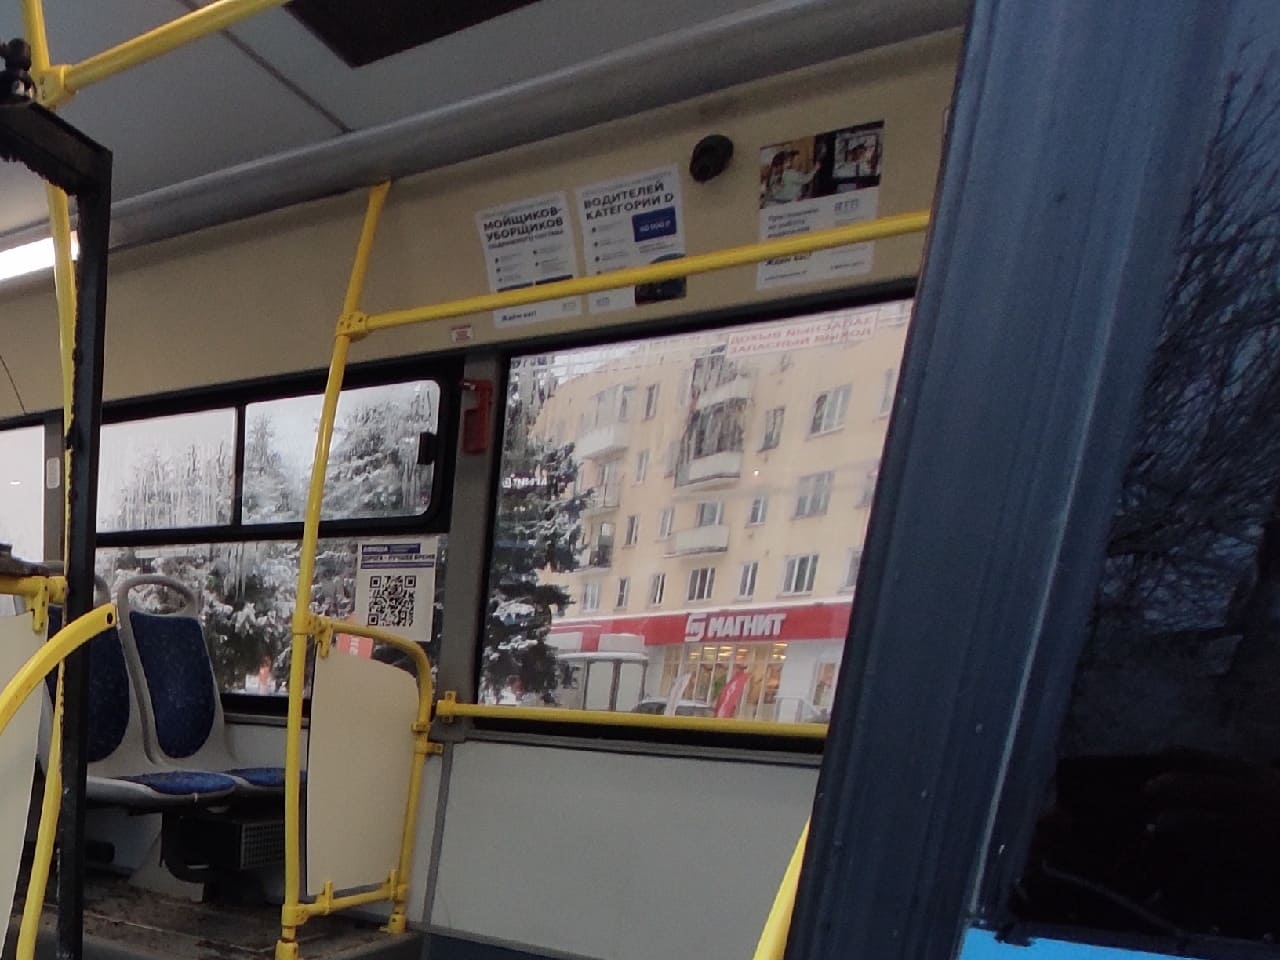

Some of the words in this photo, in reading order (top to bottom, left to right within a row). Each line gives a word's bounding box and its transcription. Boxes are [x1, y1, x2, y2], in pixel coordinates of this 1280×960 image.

[584, 180, 664, 209] ВОДИТЕЛЕЙ
[586, 196, 661, 221] КАТЕГОРИИ
[664, 193, 674, 203] D
[483, 206, 563, 231] МОЙЩИКОВ-
[486, 217, 564, 242] УБОРЩИКОВ
[707, 614, 786, 636] МАГНИТ
